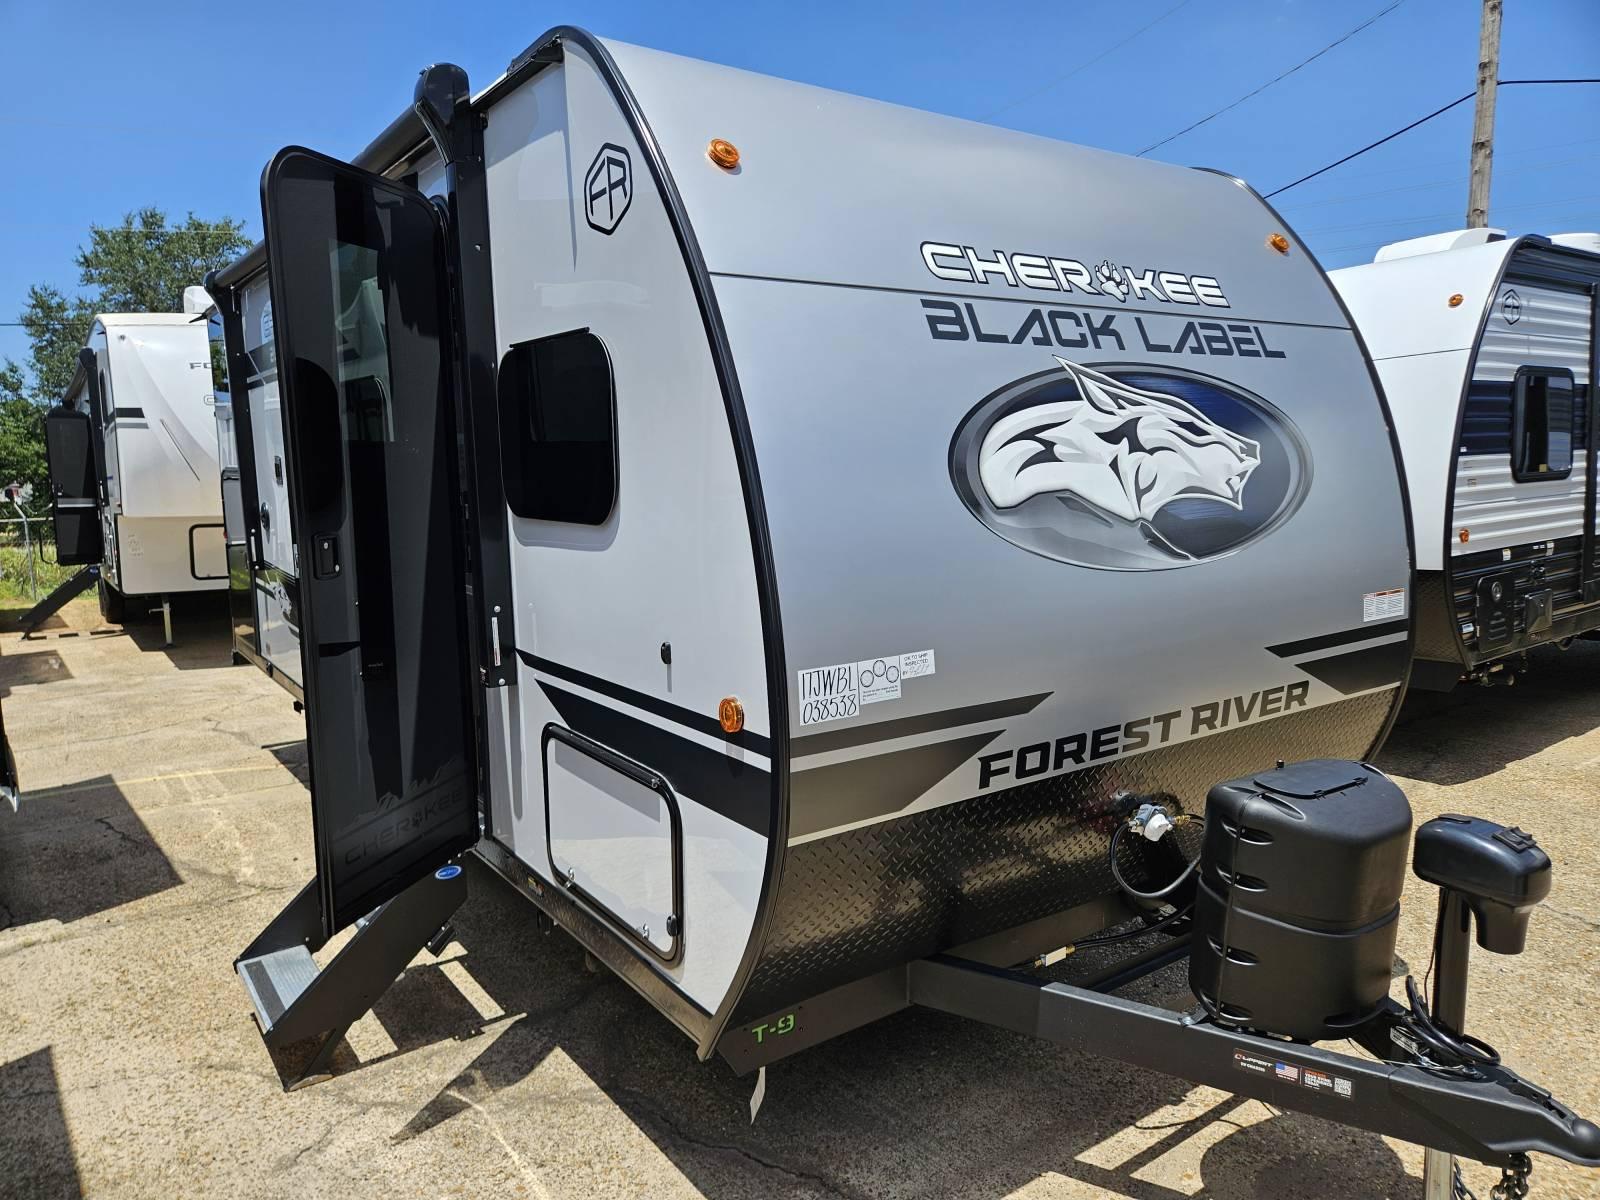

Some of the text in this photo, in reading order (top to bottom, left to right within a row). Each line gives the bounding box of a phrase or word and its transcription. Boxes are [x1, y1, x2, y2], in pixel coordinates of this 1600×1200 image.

[920, 299, 1287, 359] BLACK LABEL
[803, 694, 857, 724] 038538
[978, 680, 1310, 790] FOREST RIVER
[752, 1014, 795, 1043] T-9
